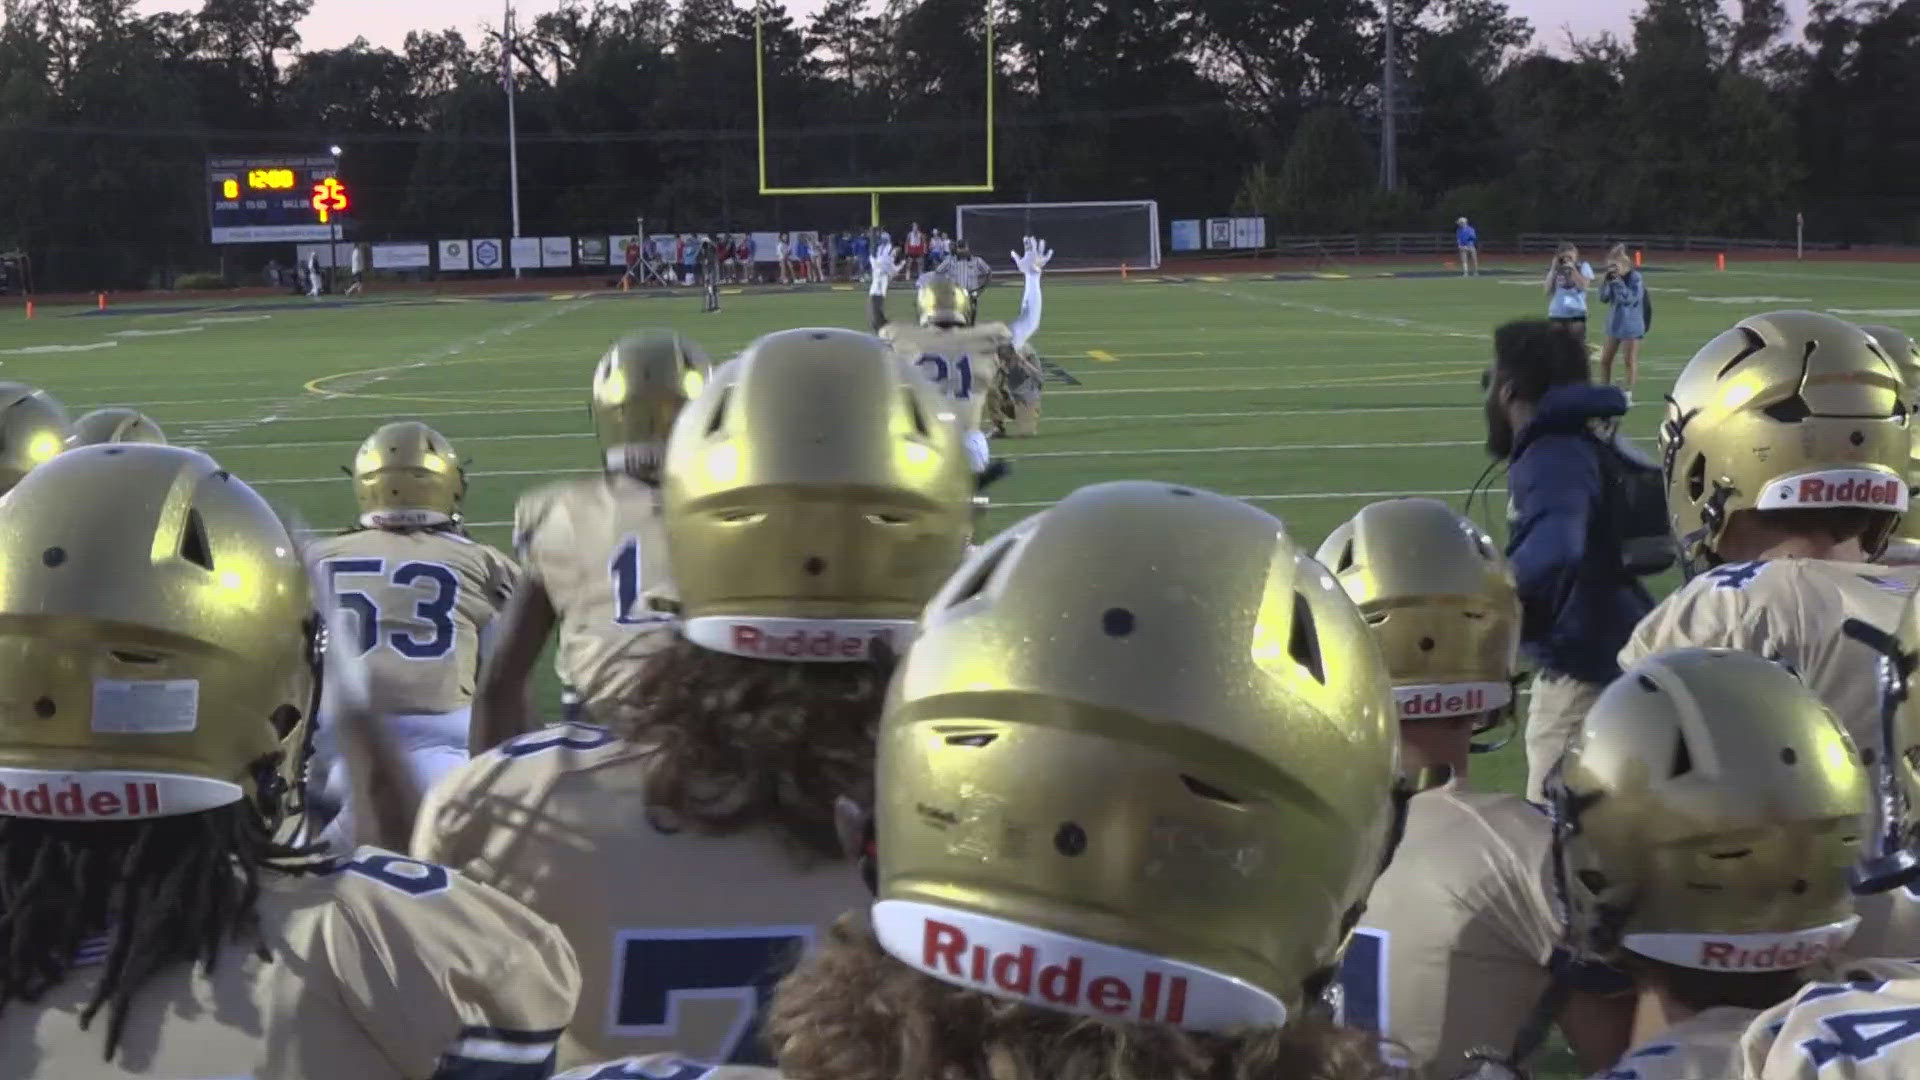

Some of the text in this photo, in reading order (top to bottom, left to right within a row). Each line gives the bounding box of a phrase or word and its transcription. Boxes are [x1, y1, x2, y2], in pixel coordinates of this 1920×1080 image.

[313, 184, 347, 211] 25
[1798, 477, 1899, 506] Riddell
[319, 557, 459, 661] 53
[921, 918, 1189, 1026] Riddell
